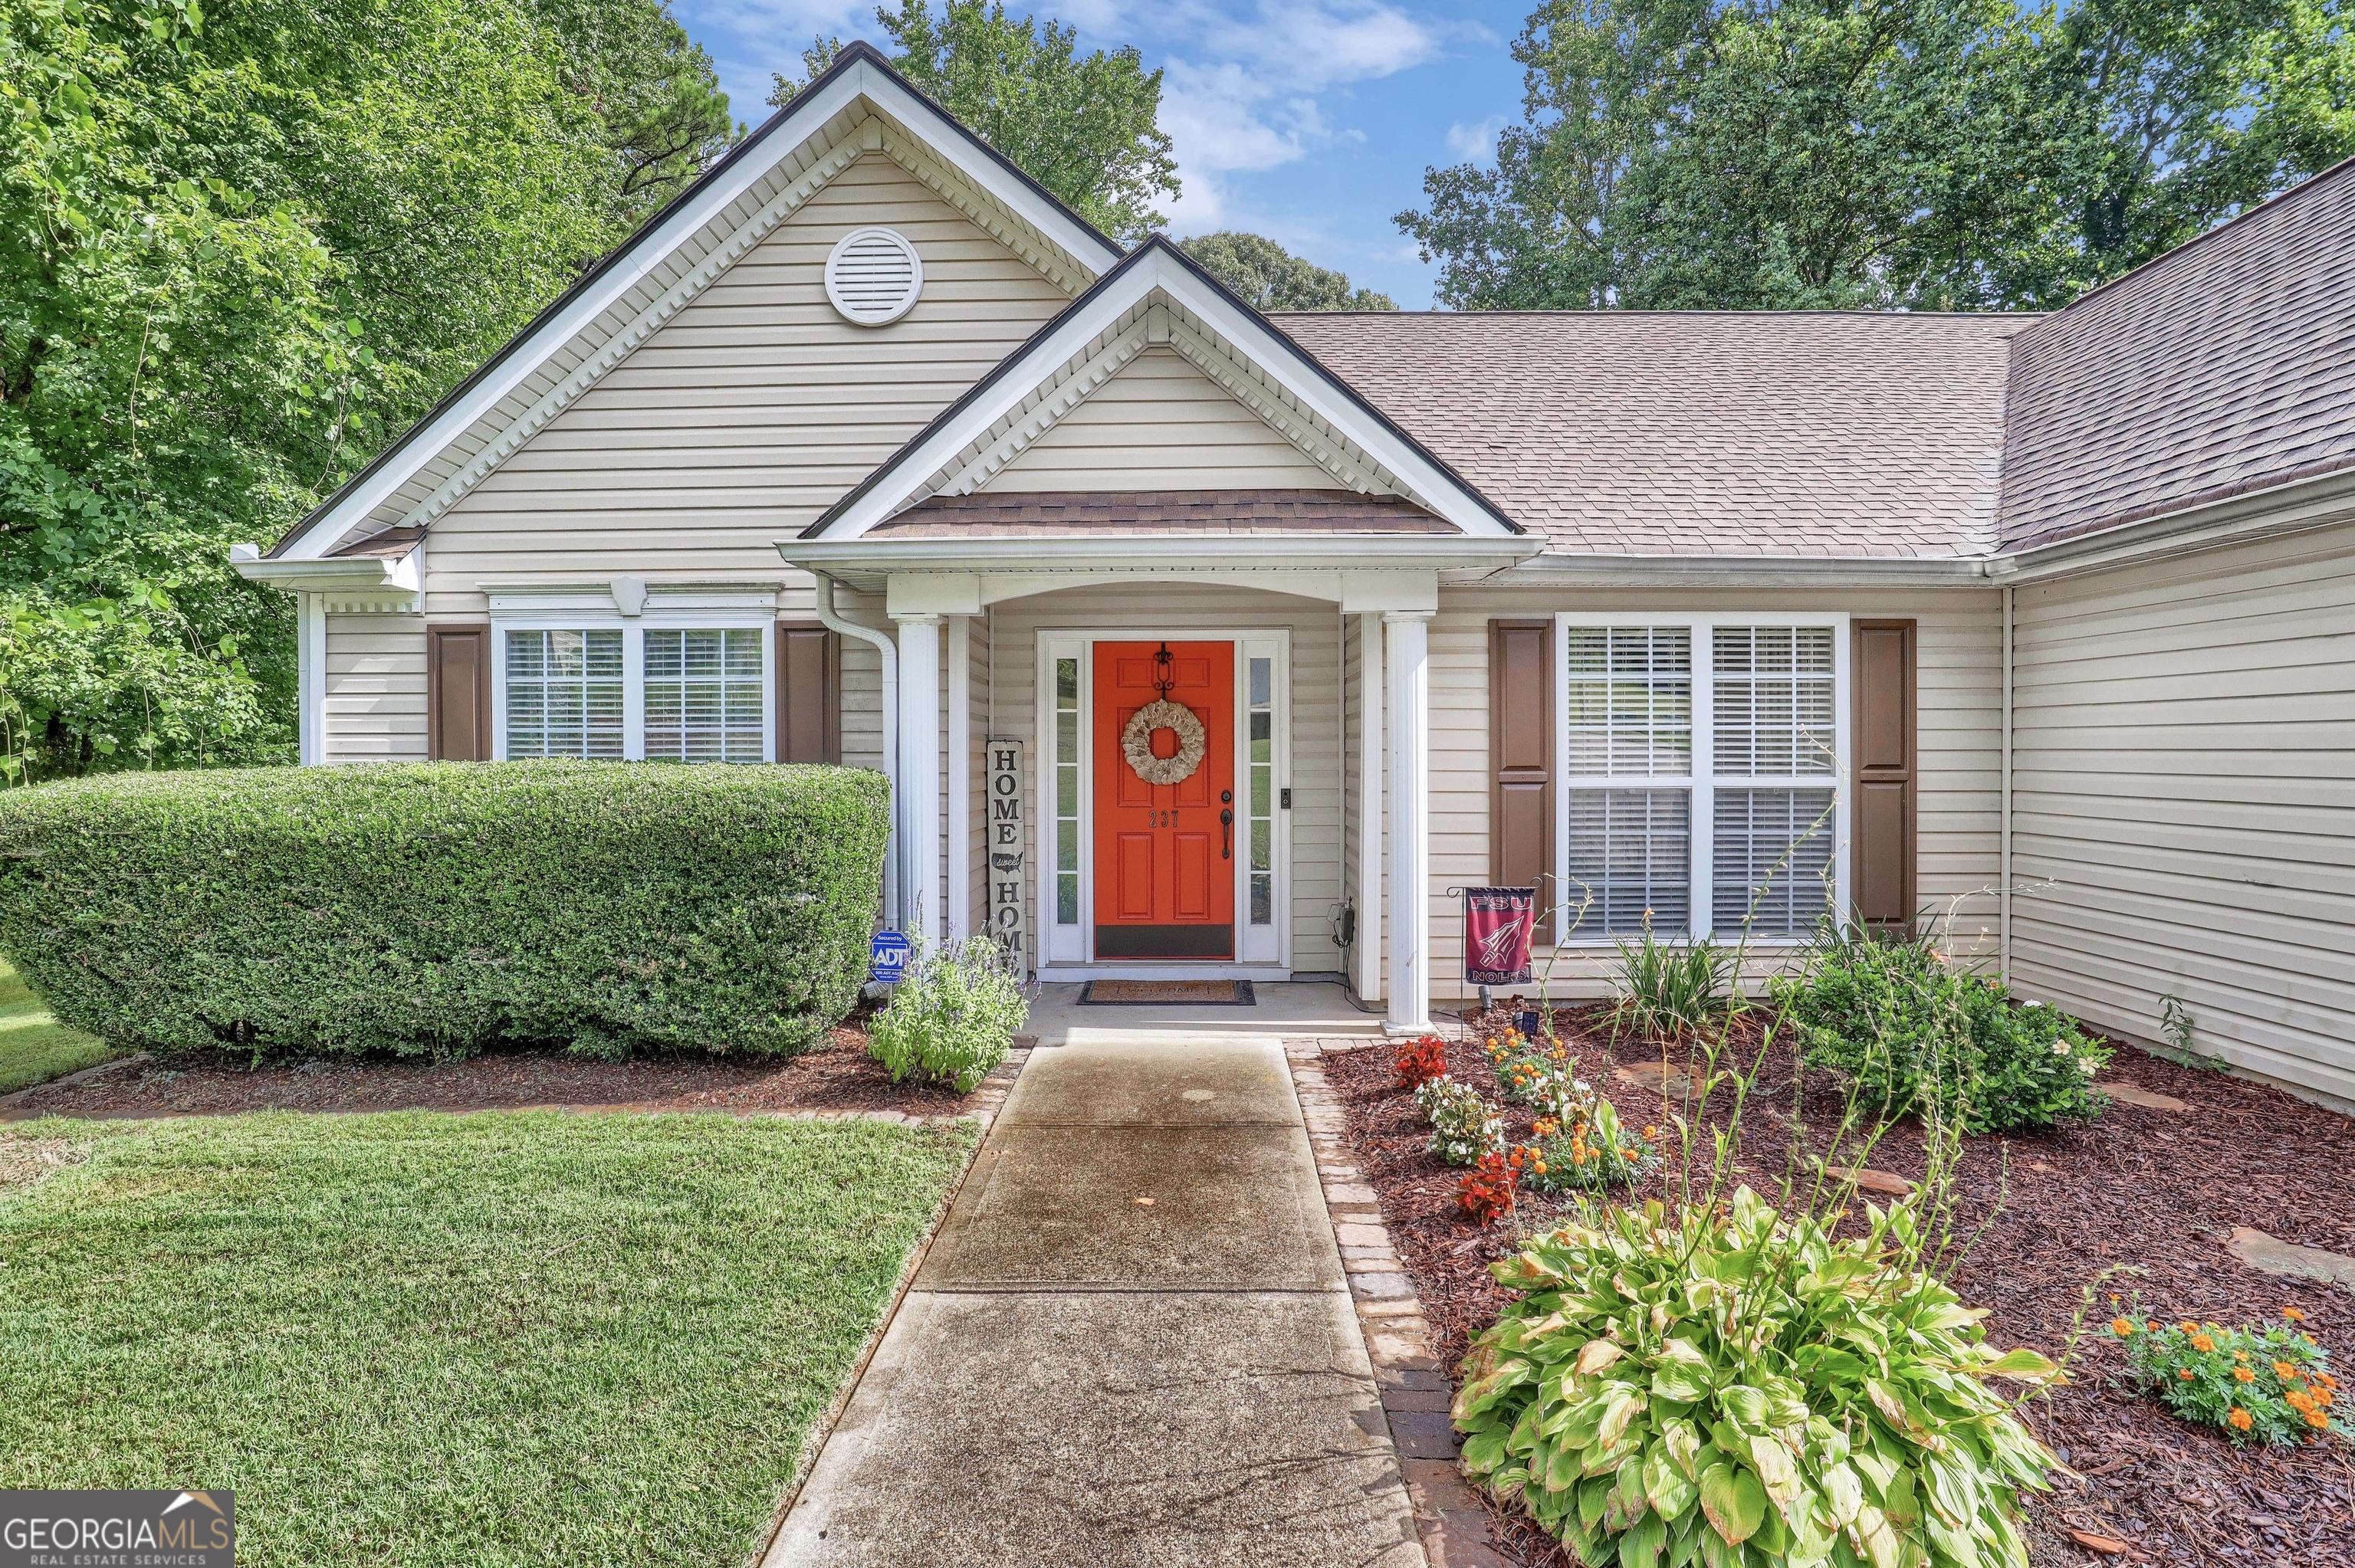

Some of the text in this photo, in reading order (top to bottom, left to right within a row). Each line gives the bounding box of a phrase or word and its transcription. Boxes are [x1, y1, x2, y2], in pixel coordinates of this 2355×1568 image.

[994, 750, 1019, 845] HOME
[1149, 810, 1178, 828] 237
[996, 857, 1020, 867] sweet
[1470, 896, 1532, 910] FSU
[874, 948, 907, 966] ADT
[1473, 970, 1526, 982] NOLES
